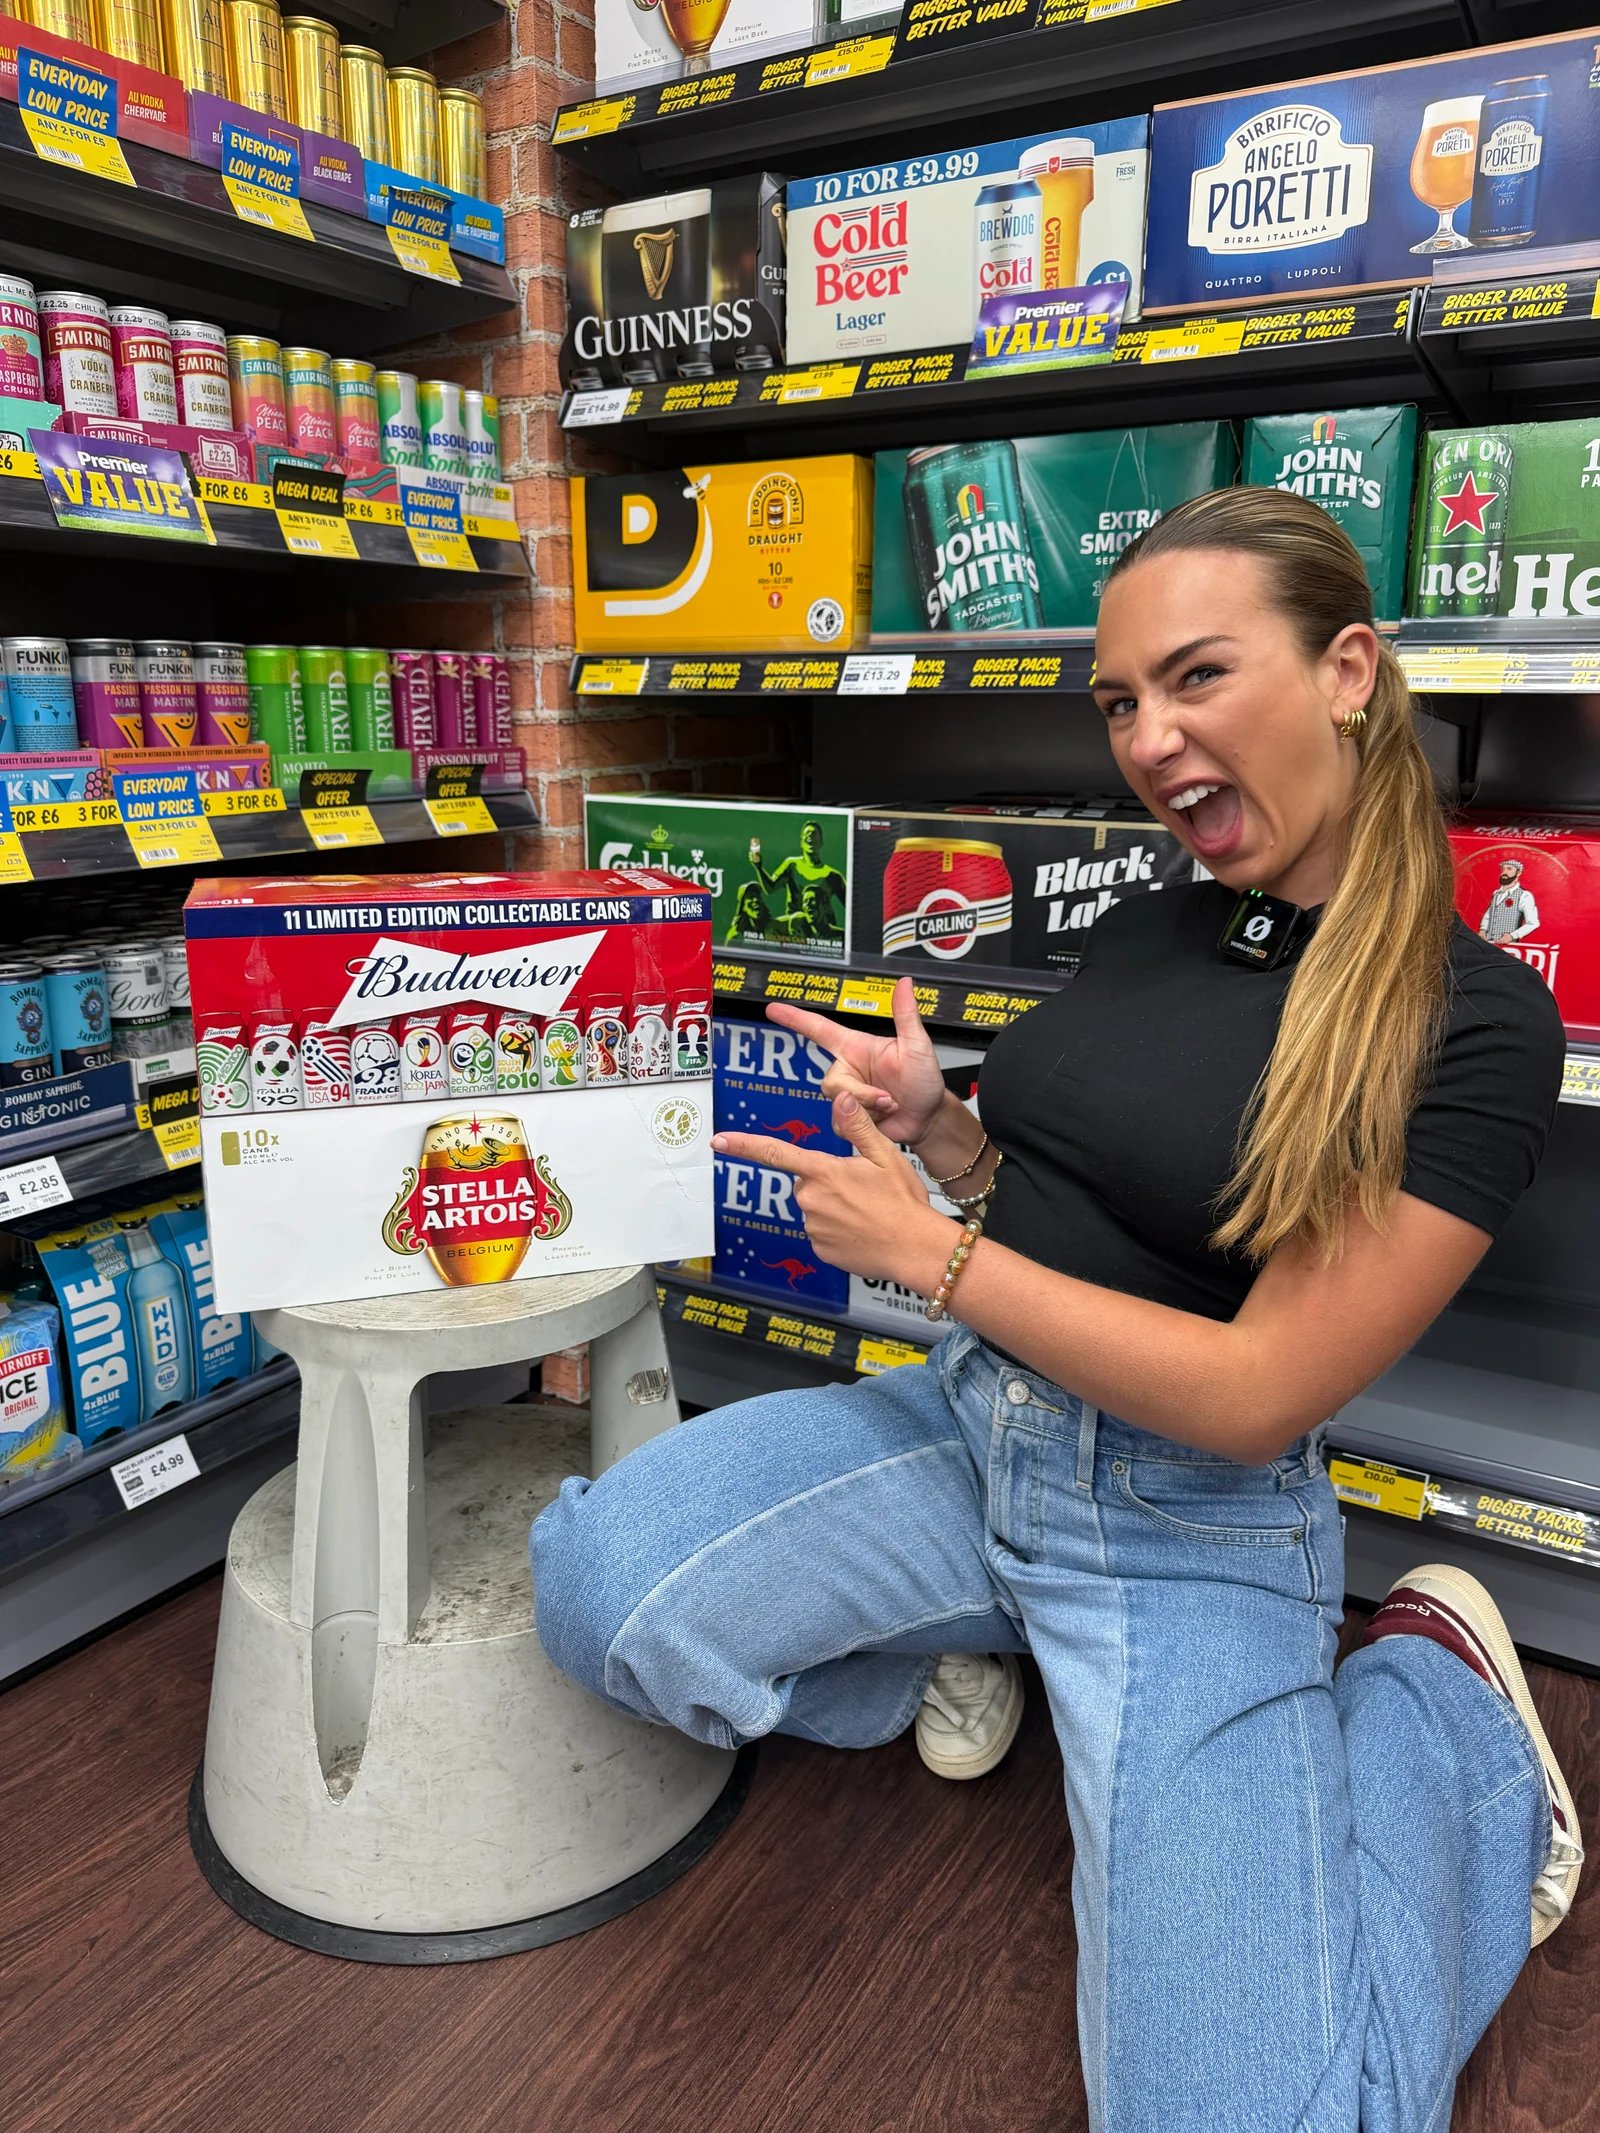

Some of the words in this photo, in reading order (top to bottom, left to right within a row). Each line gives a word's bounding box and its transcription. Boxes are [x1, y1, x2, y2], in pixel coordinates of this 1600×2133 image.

[905, 9, 972, 41] BETTER
[976, 0, 1028, 24] VALUE
[838, 45, 865, 57] £15.00
[29, 58, 109, 102] EVERYDAY
[661, 82, 699, 101] BIGGER
[699, 74, 736, 93] PACKS,
[28, 88, 63, 116] LOW
[64, 101, 111, 131] PRICE
[128, 91, 139, 104] AU
[140, 93, 165, 112] VODKA
[657, 96, 698, 115] BETTER
[699, 88, 734, 106] VALUE
[125, 104, 168, 124] CHERRYADE
[37, 118, 58, 133] ANY
[59, 126, 67, 136] 2
[70, 129, 91, 143] FOR
[92, 136, 107, 149] £5
[1235, 112, 1332, 150] BIRRIFICIO
[230, 132, 291, 168] EVERYDAY
[1243, 139, 1317, 175] ANGELO
[1485, 142, 1537, 168] PORETTI
[319, 155, 330, 167] AU
[330, 157, 348, 171] VODKA
[228, 156, 255, 181] LOW
[256, 167, 294, 193] PRICE
[313, 165, 333, 181] BLACK
[333, 169, 353, 185] GRAPE
[814, 180, 842, 203] 10
[846, 168, 899, 200] FOR
[903, 152, 980, 188] £9.99
[1207, 164, 1352, 234] PORETTI
[391, 209, 413, 228] LOW
[415, 217, 447, 237] PRICE
[813, 200, 909, 259] Cold
[979, 212, 1035, 242] BREWDOG
[1224, 233, 1260, 246] BIRRA
[1266, 223, 1328, 242] ITALIANA
[979, 256, 1033, 290] Cold
[1205, 275, 1262, 290] QUATTRO
[1286, 265, 1341, 281] LUPPOLI
[815, 264, 909, 307] Beer
[1442, 289, 1507, 310] BIGGER
[1508, 283, 1568, 303] PACKS,
[836, 310, 886, 331] Lager
[1014, 301, 1084, 320] Premier
[1245, 314, 1303, 332] BIGGER
[1303, 307, 1355, 325] PACKS,
[1441, 306, 1508, 327] BETTER
[1512, 300, 1568, 319] VALUE
[574, 299, 753, 361] GUINNESS
[984, 314, 1110, 359] VALUE
[1183, 326, 1216, 338] £10.00
[1242, 329, 1302, 347] BETTER
[1305, 322, 1355, 340] VALUE
[81, 360, 108, 374] VODKA
[868, 358, 914, 375] BIGGER
[915, 353, 954, 371] PACKS,
[865, 371, 911, 389] BETTER
[913, 367, 951, 385] VALUE
[588, 402, 620, 415] £14.99
[78, 450, 149, 476] Premier
[209, 450, 232, 466] £2.25
[1275, 447, 1364, 482] JOHN
[53, 466, 191, 520] VALUE
[206, 482, 229, 500] FOR
[234, 486, 249, 502] £6
[277, 480, 310, 501] MEGA
[311, 487, 339, 505] DEAL
[408, 493, 456, 512] EVERYDAY
[752, 478, 801, 516] BODDINGTONS
[409, 511, 431, 528] LOW
[432, 515, 459, 532] PRICE
[1099, 509, 1164, 531] EXTRA
[747, 533, 804, 547] DRAUGHT
[934, 520, 1022, 580] JOHN
[768, 562, 784, 576] 10
[927, 553, 1040, 630] SMITH'S
[954, 593, 1024, 623] TADCASTER
[864, 668, 900, 681] £13.29
[973, 659, 1017, 672] BIGGER
[1018, 657, 1062, 671] PACKS,
[969, 672, 1016, 686] BETTER
[1019, 671, 1060, 686] VALUE
[145, 684, 182, 696] PASSION
[427, 755, 470, 768] PASSION
[471, 753, 500, 766] FRUIT
[123, 776, 189, 797] EVERYDAY
[312, 772, 357, 787] SPECIAL
[127, 802, 156, 819] LOW
[158, 799, 195, 816] PRICE
[226, 796, 234, 811] 3
[237, 795, 259, 811] FOR
[263, 793, 279, 809] £6
[316, 790, 351, 808] OFFER
[1033, 845, 1157, 898] Black
[284, 910, 302, 930] 11
[305, 909, 383, 929] LIMITED
[387, 906, 461, 928] EDITION
[465, 902, 581, 924] COLLECTABLE
[586, 901, 631, 920] CANS
[663, 897, 680, 919] 10
[679, 904, 704, 915] CANS
[919, 911, 974, 937] CARLING
[344, 952, 584, 999] Budweiser
[768, 969, 804, 985] BIGGER
[804, 975, 841, 993] PACKS,
[764, 985, 804, 1001] BETTER
[804, 989, 839, 1004] VALUE
[544, 1053, 583, 1069] Brasil
[686, 1058, 704, 1066] FIFA
[21, 1064, 52, 1083] GIN
[410, 1070, 443, 1081] KOREA
[497, 1072, 540, 1090] 2010
[592, 1075, 624, 1084] RUSSIA
[630, 1066, 672, 1079] Qatar
[674, 1070, 687, 1078] CAN
[687, 1069, 702, 1077] MEX
[702, 1068, 713, 1077] USA
[5, 1091, 44, 1109] BOMBAY
[45, 1080, 84, 1100] SAPPHIRE
[308, 1091, 330, 1104] USA
[329, 1084, 351, 1102] 94
[356, 1085, 400, 1095] FRANCE
[424, 1079, 450, 1096] JAPAN
[724, 1078, 744, 1089] THE
[747, 1082, 785, 1096] AMBER
[153, 1091, 190, 1112] MEGA
[675, 1099, 699, 1120] NATURAL
[243, 1129, 281, 1148] 10x
[431, 1127, 461, 1152] ANNO
[490, 1124, 520, 1144] 1366
[656, 1126, 698, 1147] INGREDIENTS
[243, 1146, 271, 1154] CANS
[20, 1174, 59, 1196] £2.85
[421, 1177, 536, 1208] STELLA
[420, 1200, 537, 1232] ARTOIS
[446, 1243, 515, 1260] BELGIUM
[64, 1274, 129, 1400] BLUE
[151, 1303, 177, 1360] WKD
[4, 1396, 37, 1416] ORIGINAL
[83, 1389, 121, 1411] 4xBLUE
[151, 1453, 185, 1478] £4.99
[1363, 1470, 1396, 1486] £10.00
[1476, 1495, 1532, 1523] BIGGER
[1533, 1509, 1587, 1537] PACKS,
[1475, 1514, 1533, 1541] BETTER
[1537, 1528, 1587, 1554] VALUE
